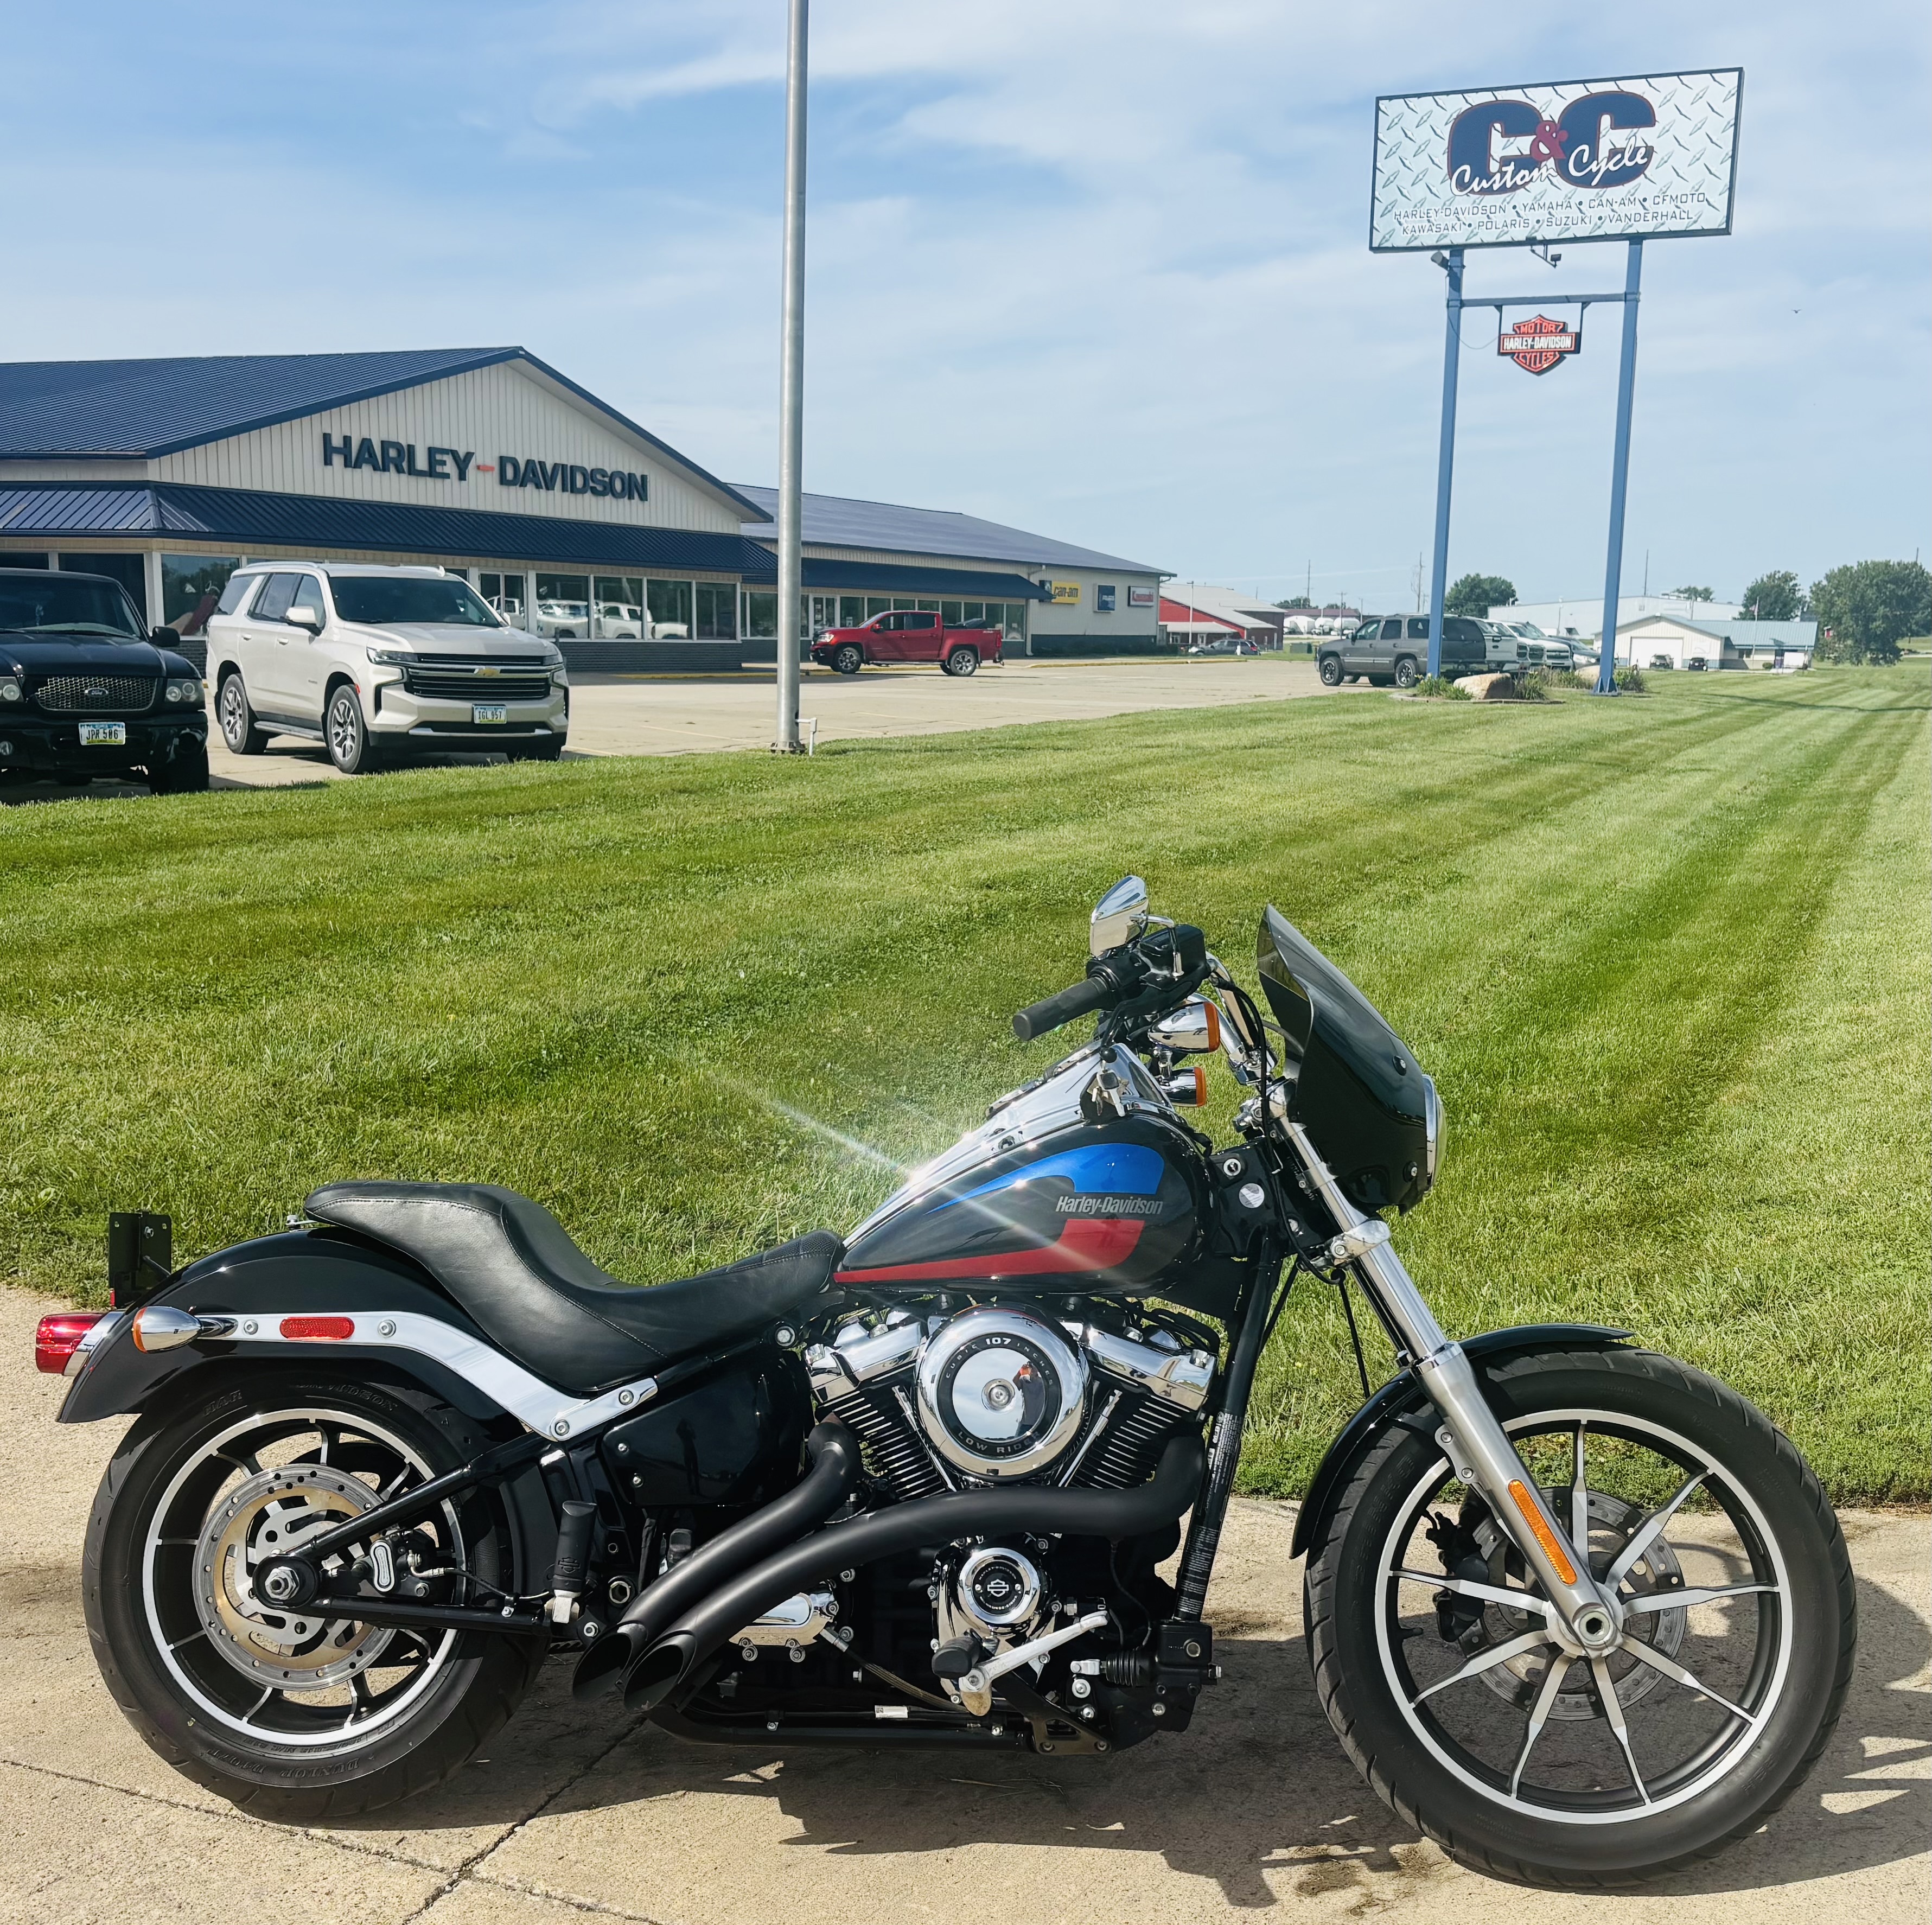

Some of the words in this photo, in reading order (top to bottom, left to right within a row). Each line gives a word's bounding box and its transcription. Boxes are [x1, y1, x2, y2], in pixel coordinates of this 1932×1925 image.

[1448, 91, 1656, 196] C&C
[1450, 161, 1558, 196] Custom
[1568, 135, 1648, 187] Cycle
[1394, 204, 1507, 220] HARLEY-DAVIDSON
[1522, 201, 1572, 213] YAMAHA
[1589, 197, 1636, 209] CAN-AM
[1653, 193, 1705, 205] CFMOTO
[1402, 222, 1462, 235] KAWASAKI
[1477, 218, 1530, 230] POLARIS
[1546, 215, 1592, 227] SUZUKI
[1608, 210, 1693, 224] VANDERHALL
[1520, 318, 1556, 334] MOTOR
[1503, 335, 1572, 350] HARLEY-DAVIDSON
[1519, 352, 1554, 368] CYCLES
[1055, 1196, 1163, 1215] Harley-Davidson
[946, 1343, 978, 1379] CUBIC
[985, 1337, 1011, 1345] 107
[1017, 1342, 1054, 1385] INCHES
[958, 1431, 987, 1451] LOW
[280, 1758, 361, 1779] DUNLOP
